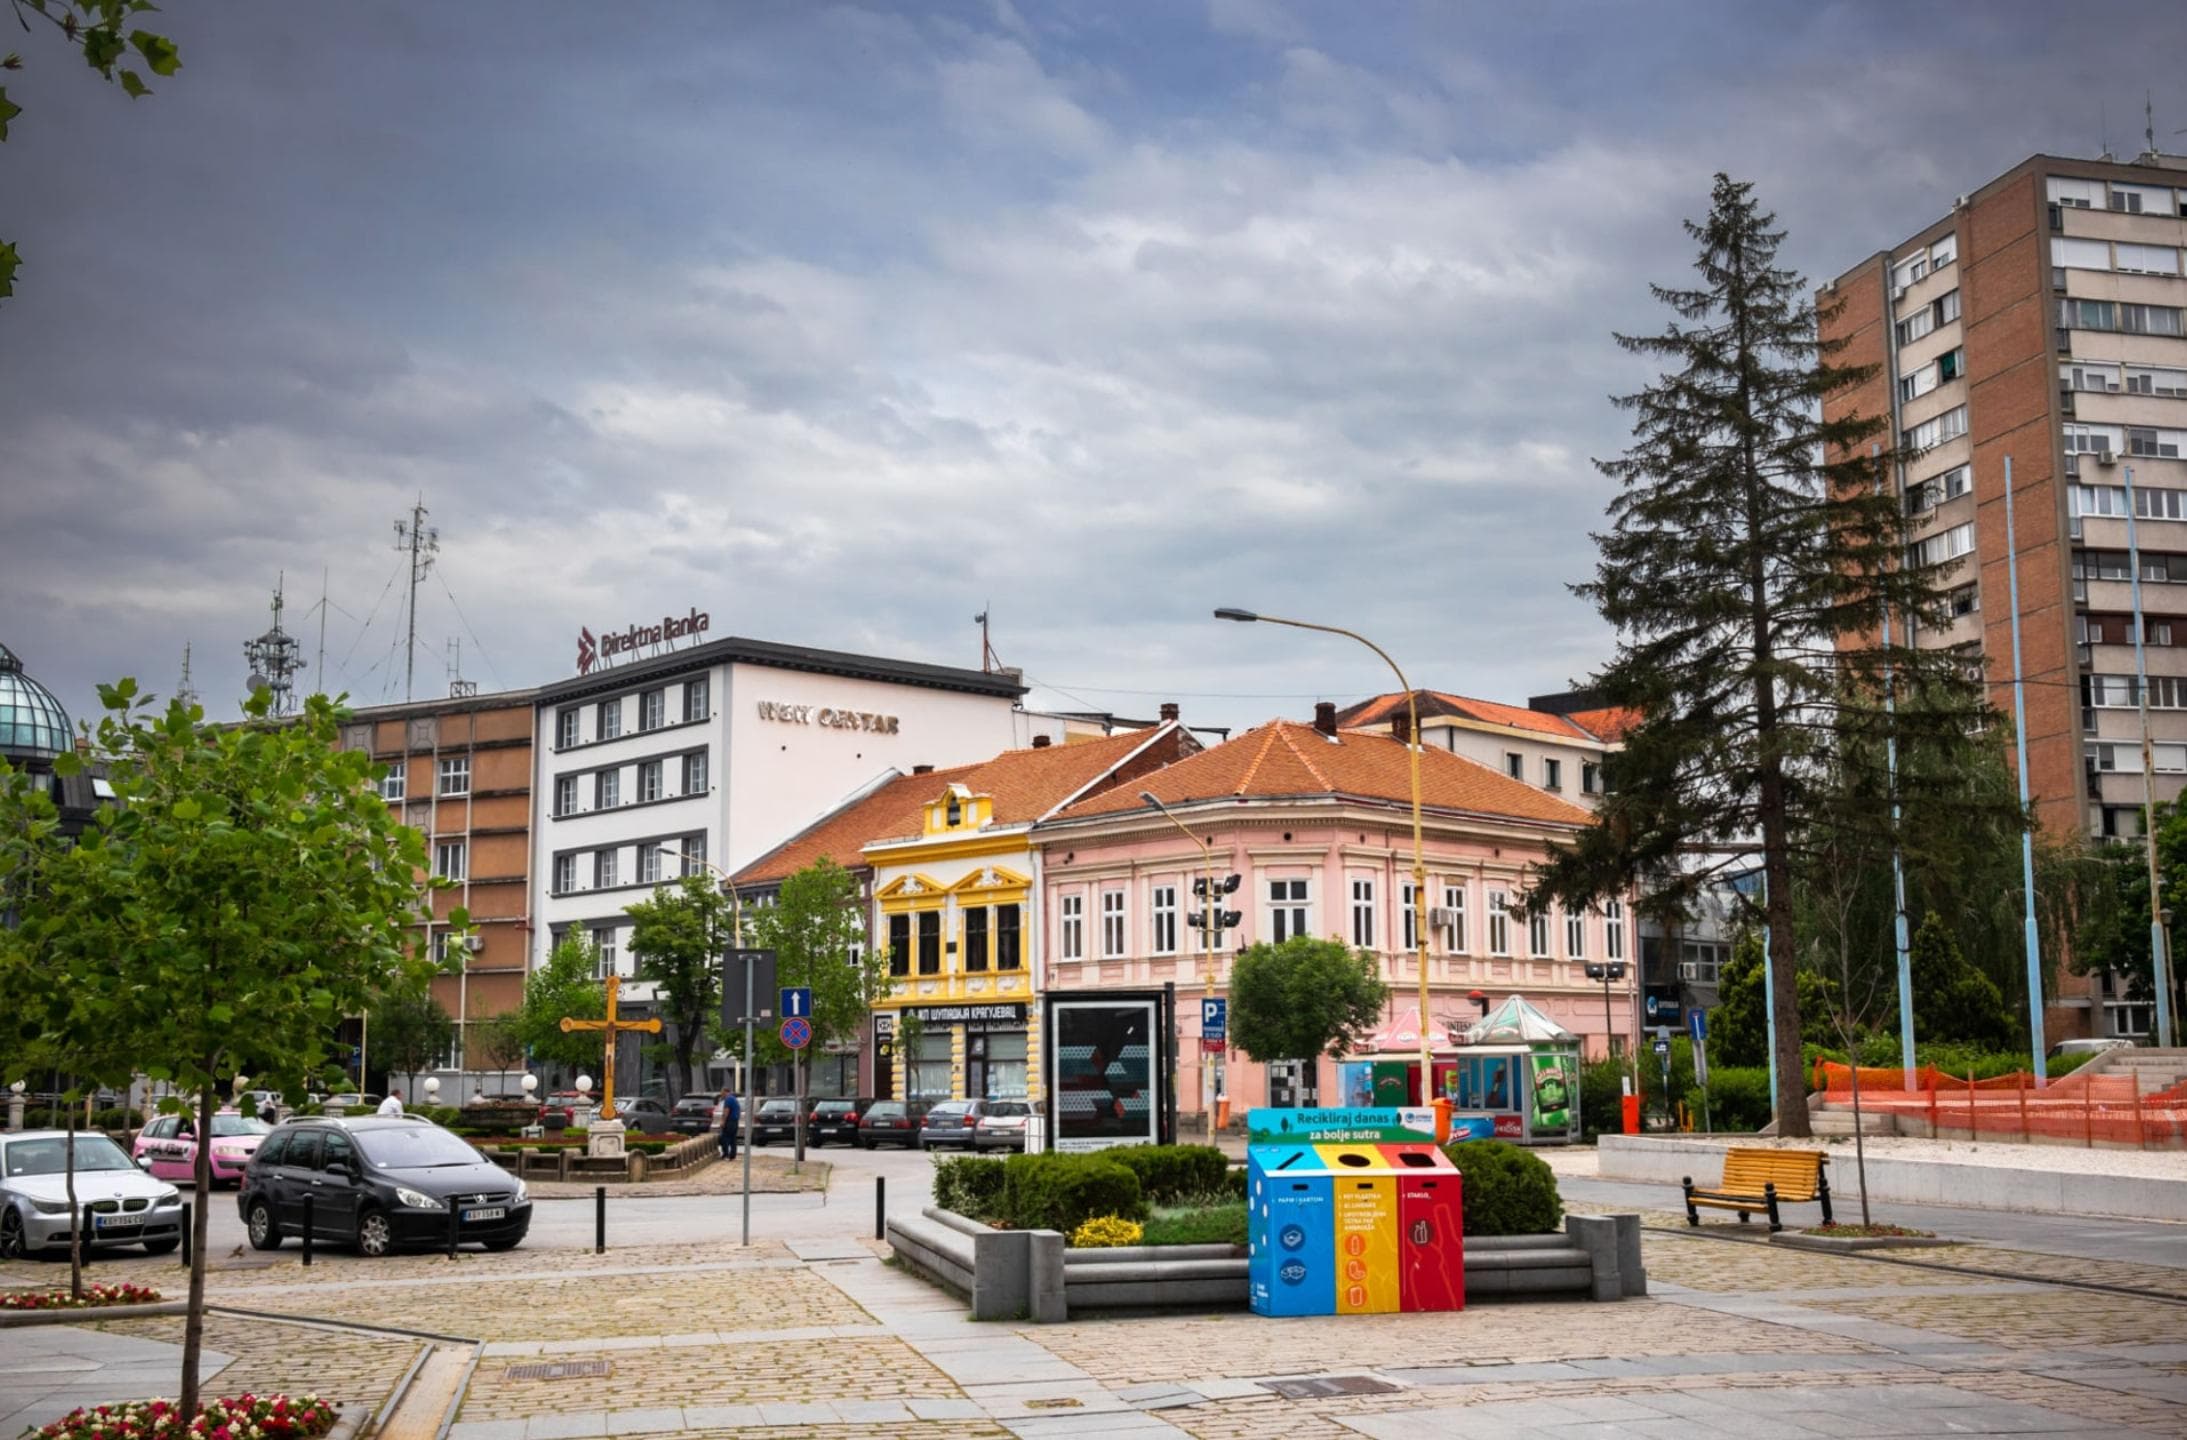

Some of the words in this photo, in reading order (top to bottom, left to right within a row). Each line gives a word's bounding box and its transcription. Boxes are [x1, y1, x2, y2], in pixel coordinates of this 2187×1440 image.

[601, 624, 661, 657] Direktna
[664, 607, 709, 641] Banka
[818, 708, 899, 735] CENTAR
[1205, 1002, 1218, 1023] P
[1297, 1112, 1352, 1126] Recikliraj
[1355, 1112, 1389, 1124] danas
[1309, 1131, 1323, 1140] za
[1324, 1129, 1350, 1142] bolje
[1353, 1130, 1381, 1140] sutra
